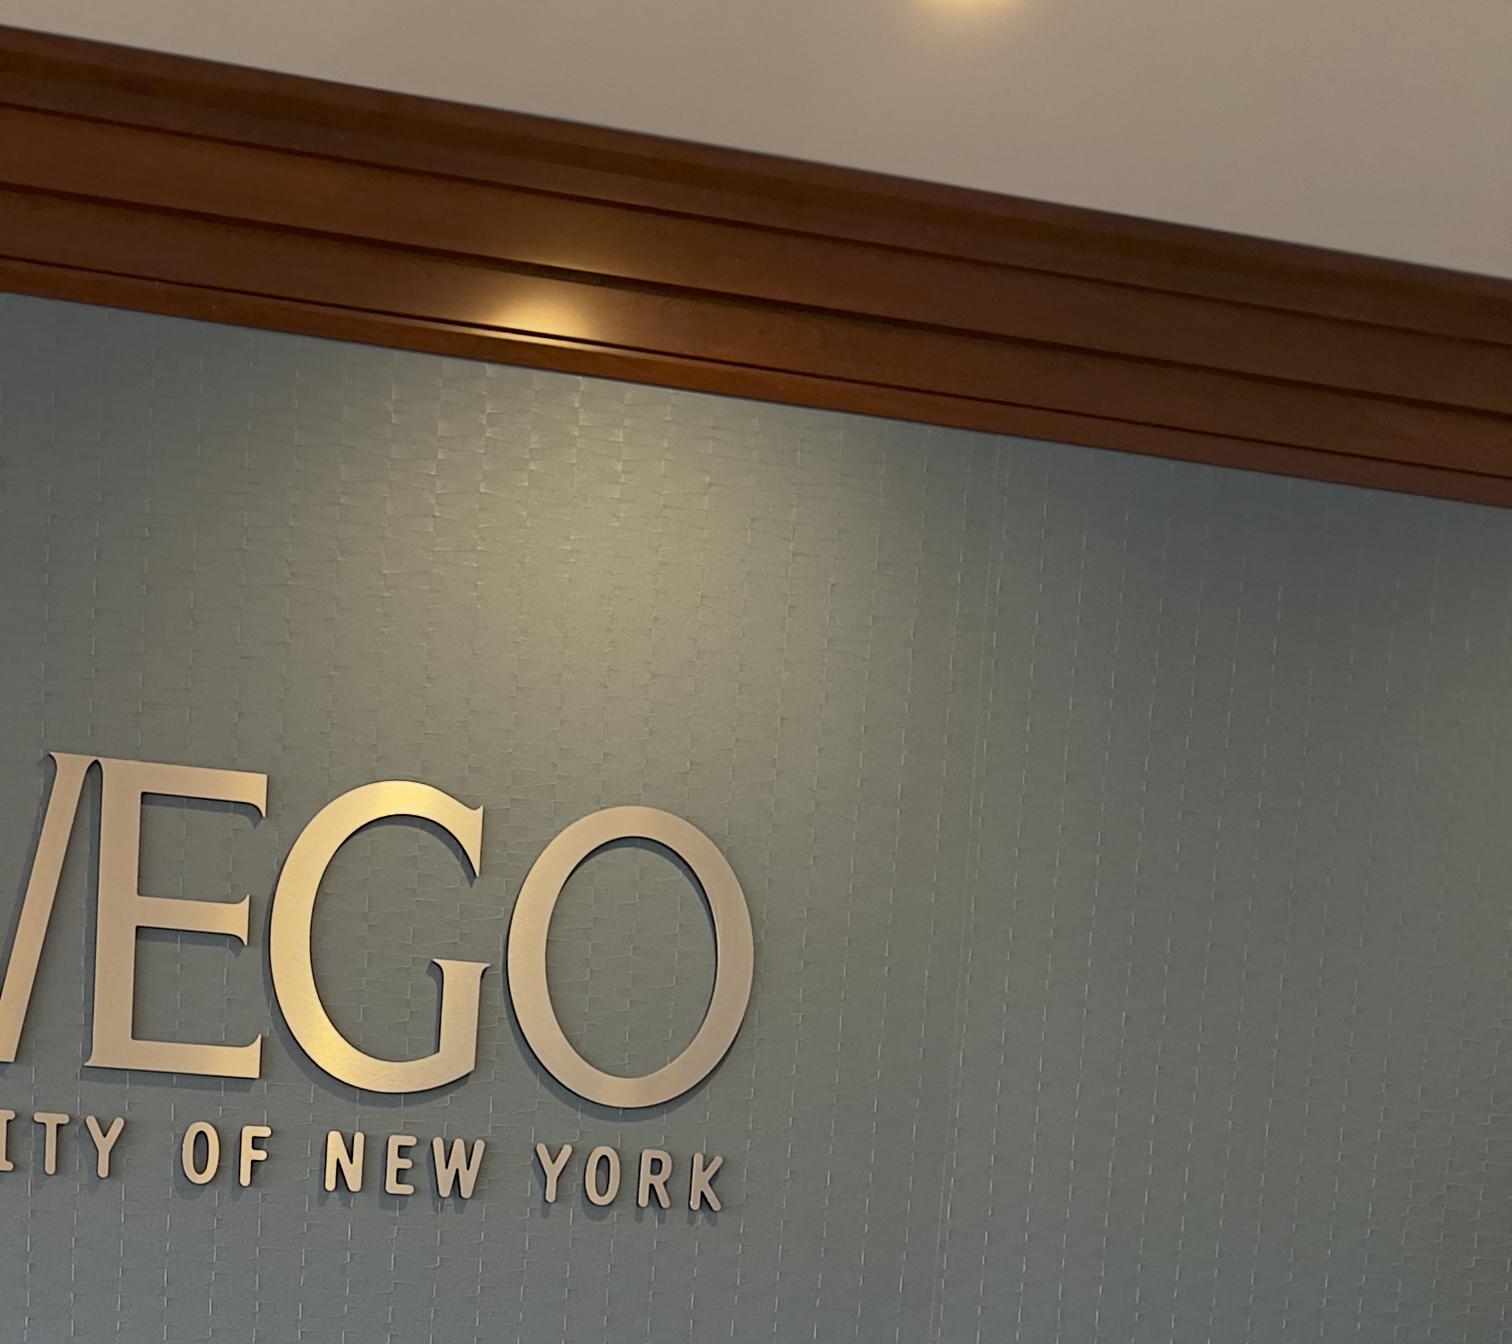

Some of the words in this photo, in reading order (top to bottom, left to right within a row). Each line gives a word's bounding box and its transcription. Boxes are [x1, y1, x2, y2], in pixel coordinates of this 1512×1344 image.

[181, 1121, 275, 1188] OF
[323, 1130, 486, 1200] NEW
[536, 1143, 727, 1213] YORK
